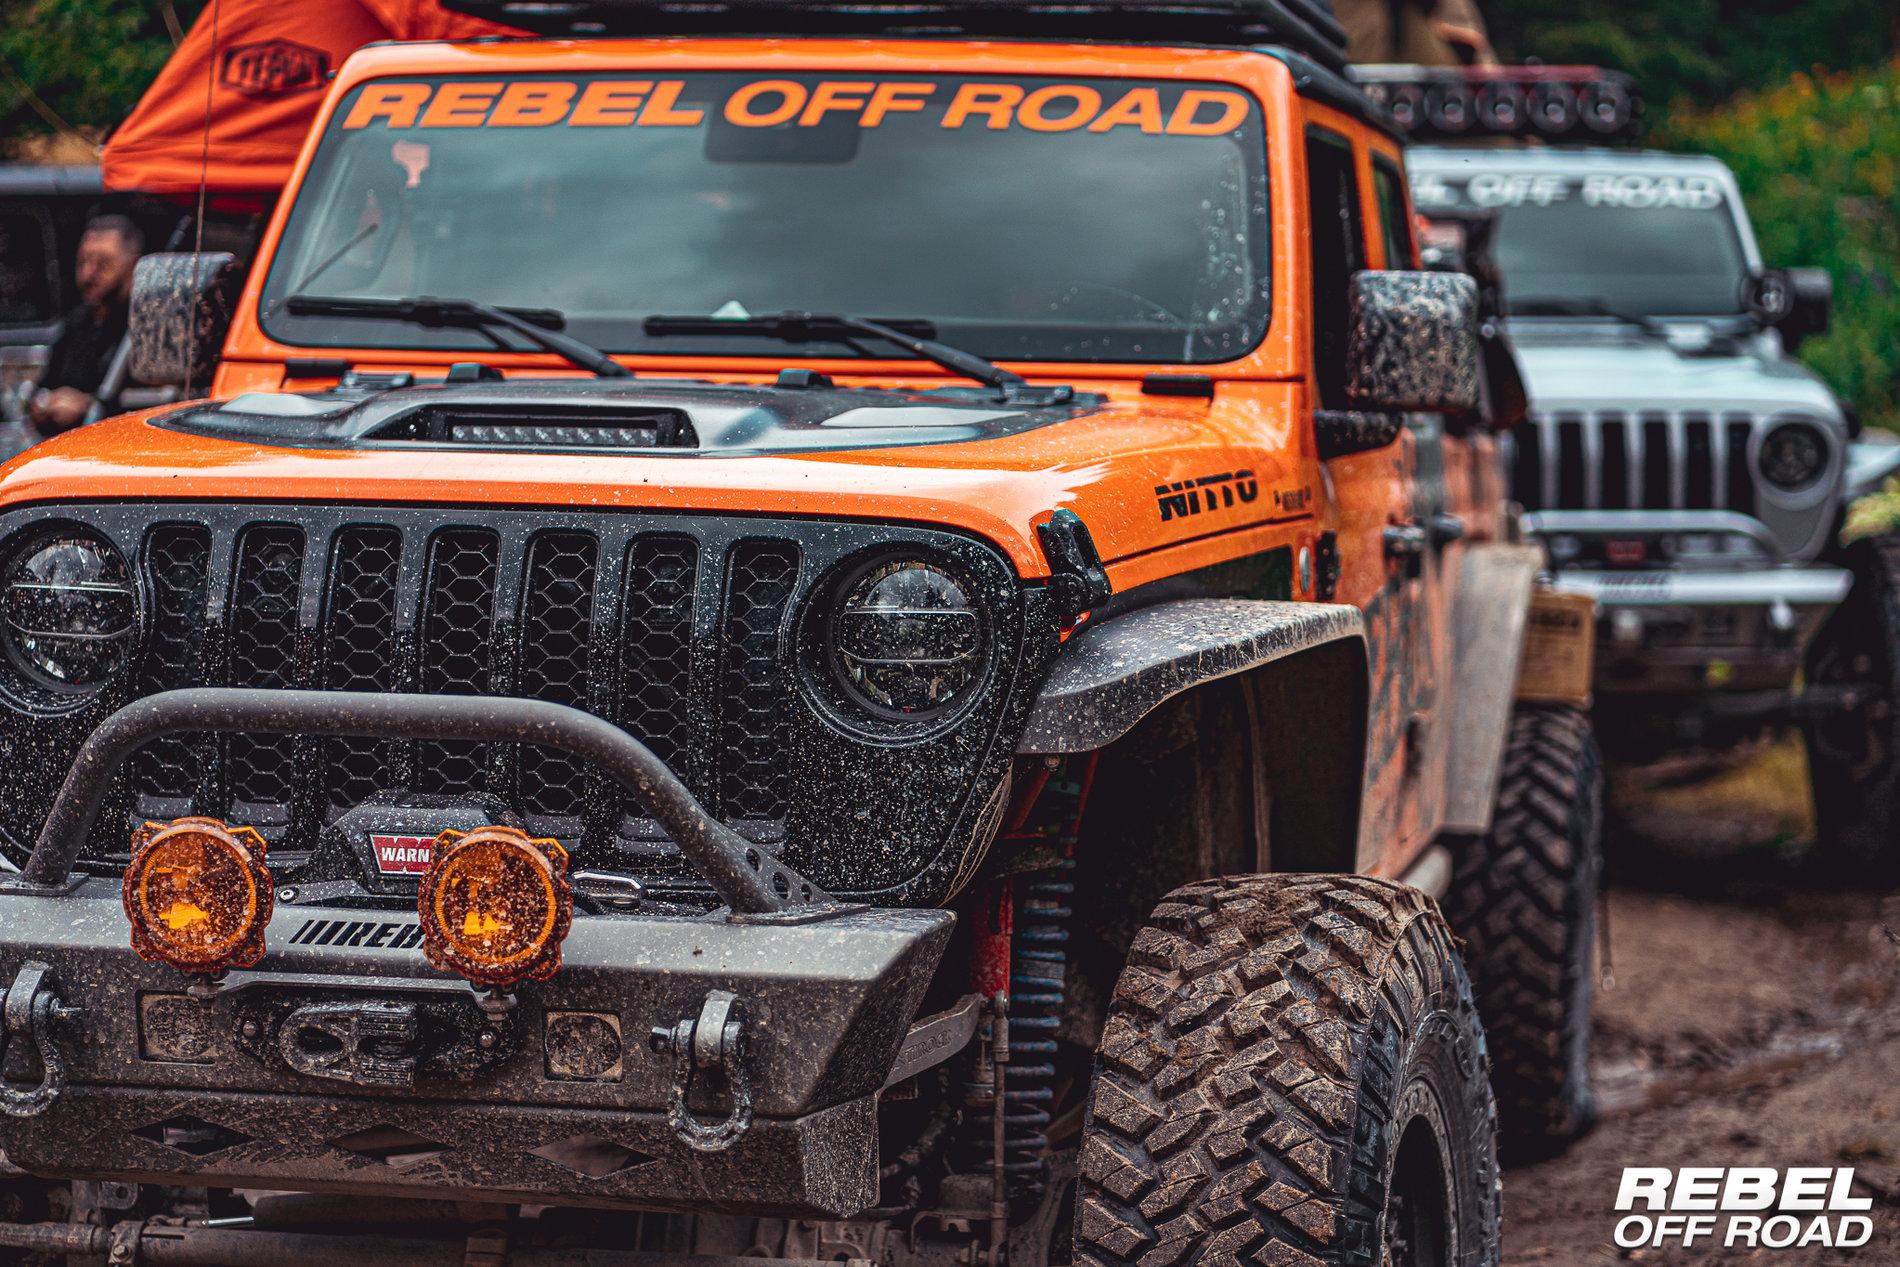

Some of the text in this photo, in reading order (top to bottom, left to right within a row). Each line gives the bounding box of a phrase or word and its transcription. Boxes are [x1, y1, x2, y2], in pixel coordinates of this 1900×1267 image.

[344, 81, 1248, 134] REBEL OFF ROAD
[1467, 173, 1570, 208] OFF
[1583, 173, 1722, 211] ROAD
[1154, 469, 1258, 521] NITTO
[380, 847, 430, 863] WARN
